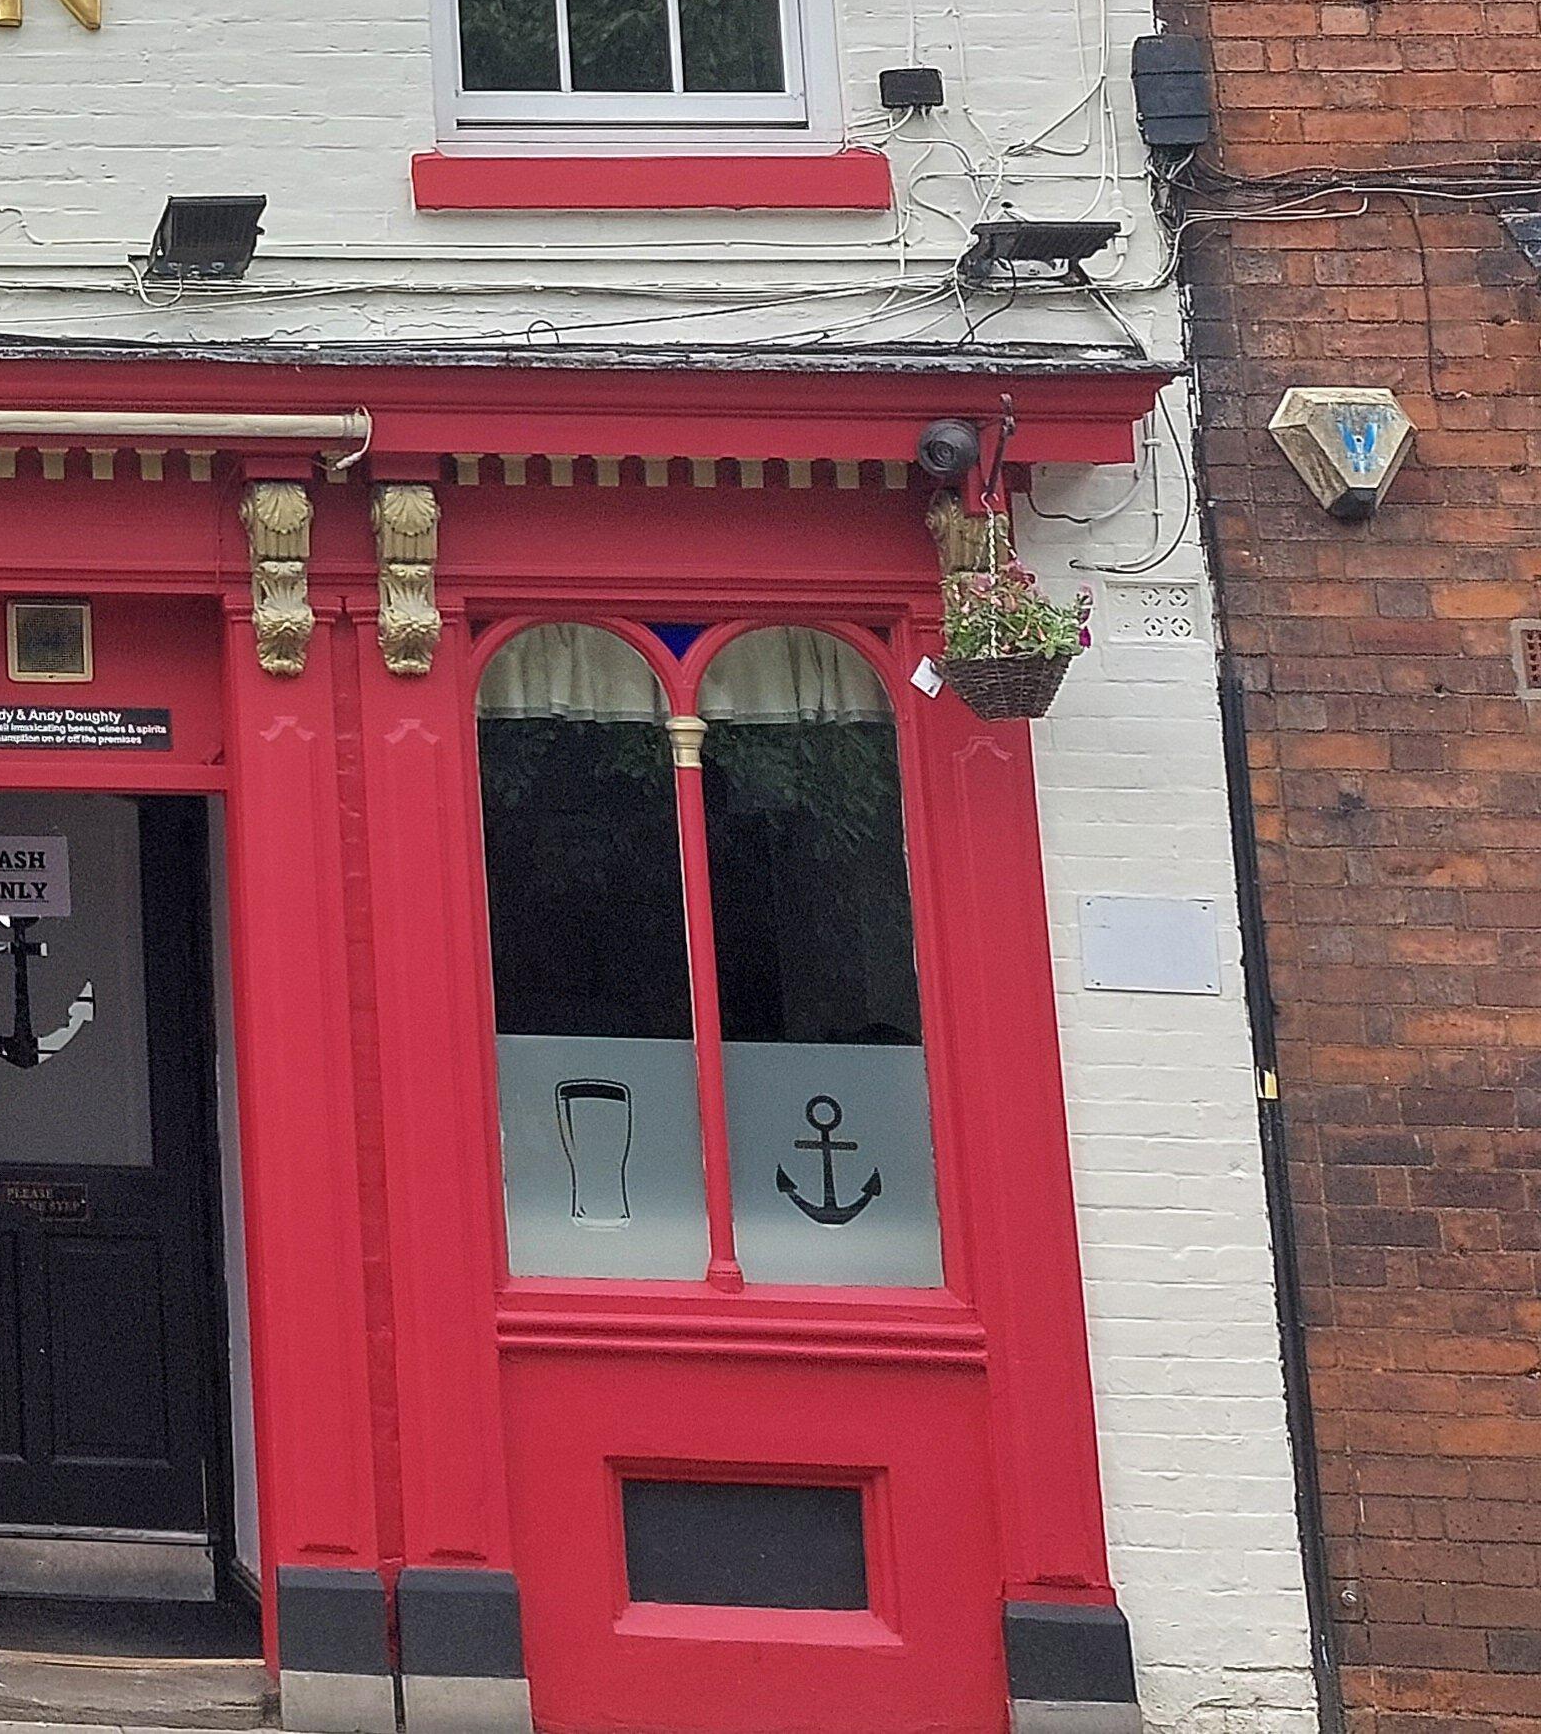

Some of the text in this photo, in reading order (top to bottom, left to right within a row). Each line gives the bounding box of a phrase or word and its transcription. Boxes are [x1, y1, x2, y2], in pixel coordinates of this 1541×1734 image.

[16, 708, 27, 721] &
[28, 709, 64, 724] Andy
[65, 709, 122, 725] Doughty
[67, 723, 97, 734] beers,
[97, 725, 126, 734] wines
[128, 723, 136, 734] &
[136, 724, 167, 735] spirits
[55, 736, 66, 744] or
[67, 734, 81, 744] off
[81, 735, 97, 744] the
[98, 735, 142, 746] premises
